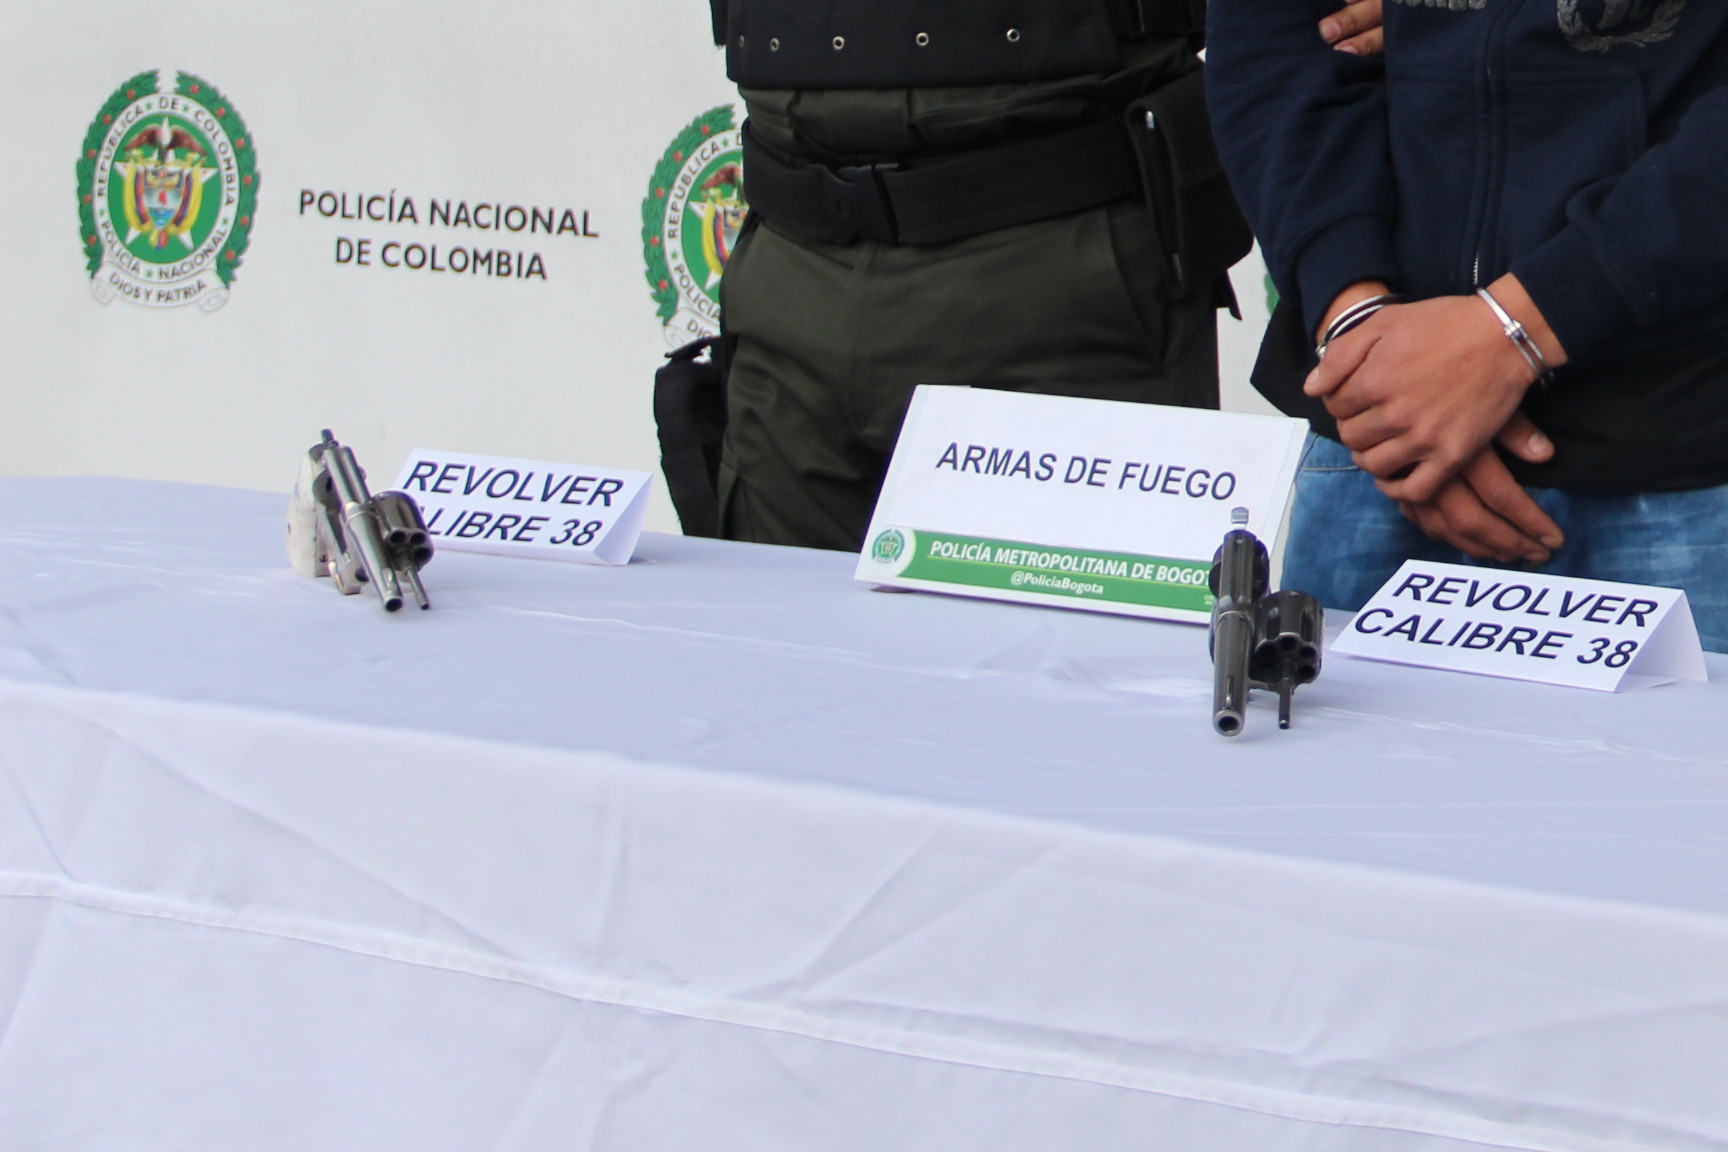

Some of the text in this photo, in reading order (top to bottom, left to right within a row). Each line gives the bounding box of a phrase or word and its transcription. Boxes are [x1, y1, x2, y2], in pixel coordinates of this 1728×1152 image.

[299, 189, 599, 238] POLICÍA NACIONAL
[335, 236, 547, 281] DE COLOMBIA
[401, 460, 624, 507] REVOLVER
[935, 442, 1237, 501] ARMAS DE FUEGO
[420, 508, 603, 547] LIBRE 38
[930, 540, 991, 561] POLICÍA
[994, 547, 1128, 578] METROPOLITANA
[1130, 562, 1155, 579] DE
[1392, 572, 1659, 628] REVOLVER
[1354, 607, 1638, 668] CALIBRE 38
